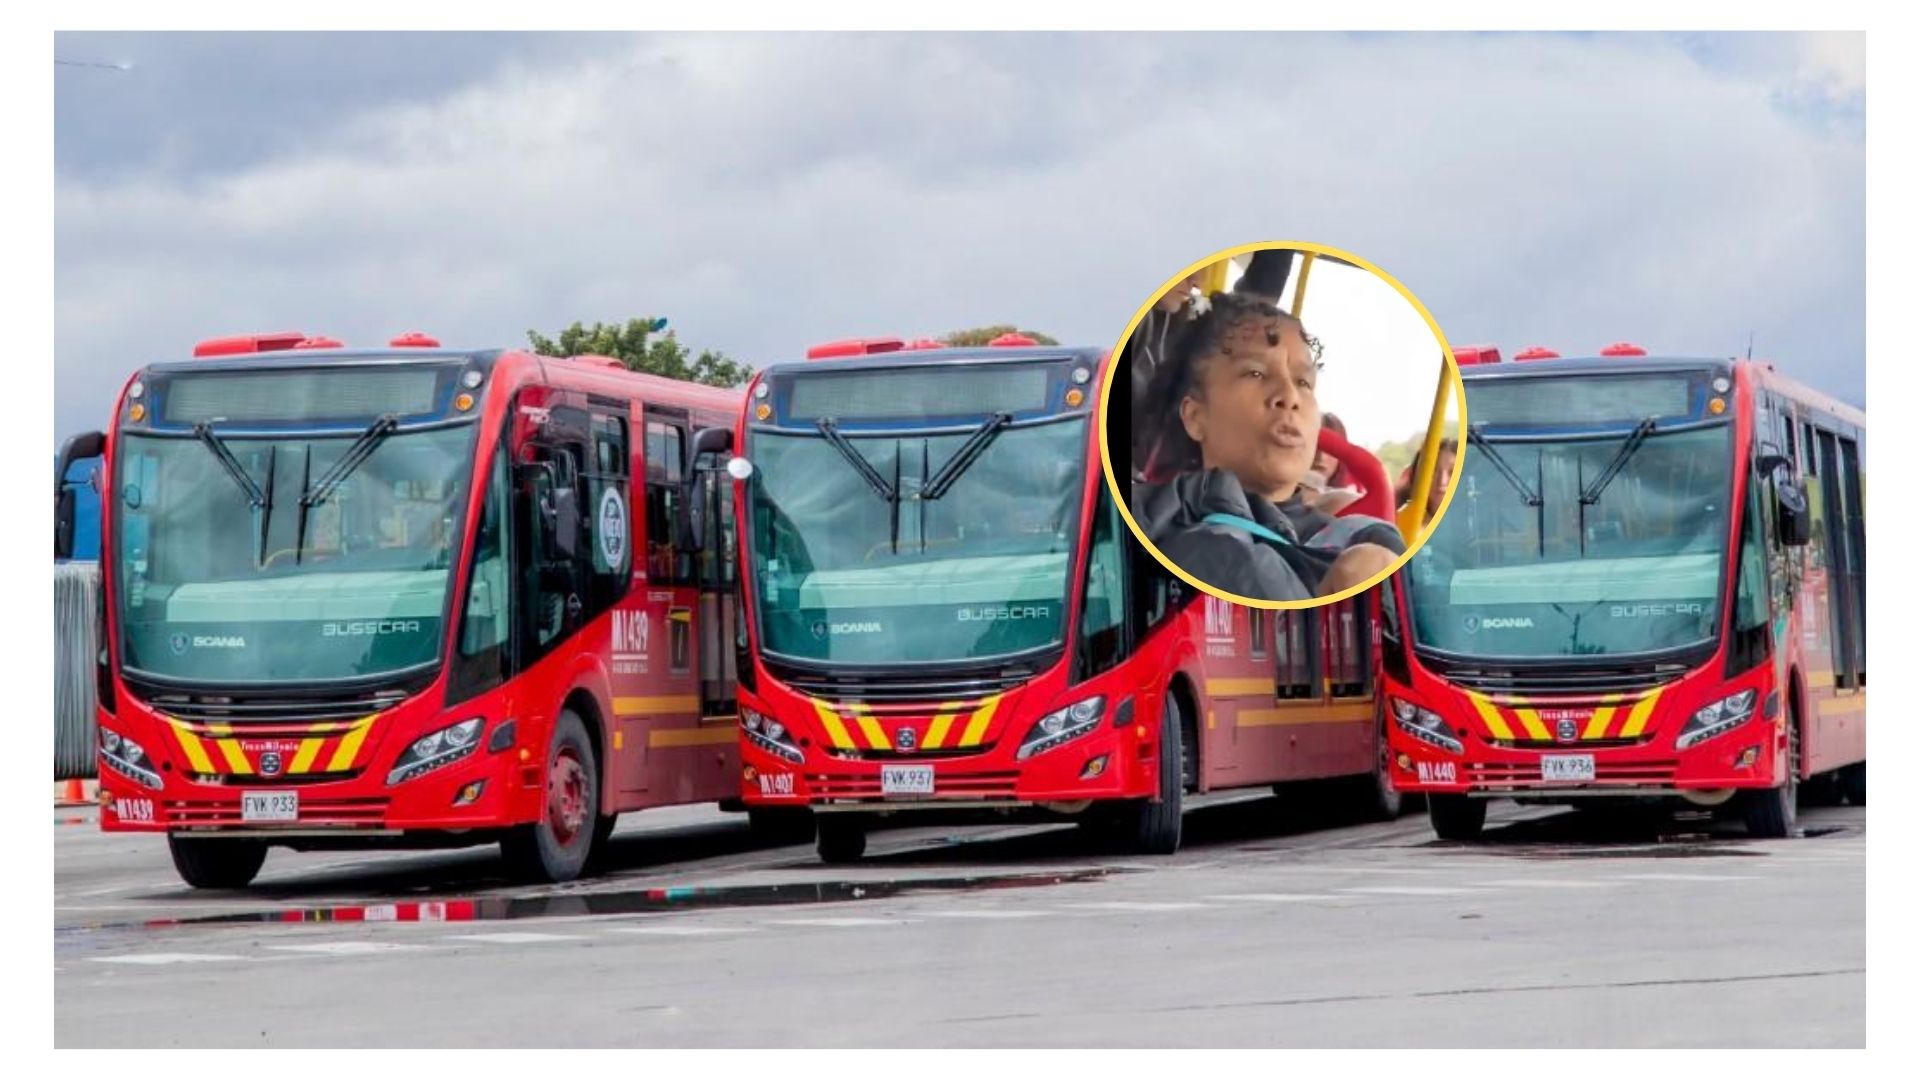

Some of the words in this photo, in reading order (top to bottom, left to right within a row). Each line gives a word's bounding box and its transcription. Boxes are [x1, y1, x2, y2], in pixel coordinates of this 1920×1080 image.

[612, 609, 648, 651] M1439
[831, 622, 882, 635] SCANIA
[1482, 617, 1534, 629] SCANIA
[193, 636, 245, 647] SCANIA
[1417, 761, 1456, 780] M1440
[117, 798, 153, 820] M1439
[244, 797, 267, 812] FVK
[272, 795, 295, 812] 933
